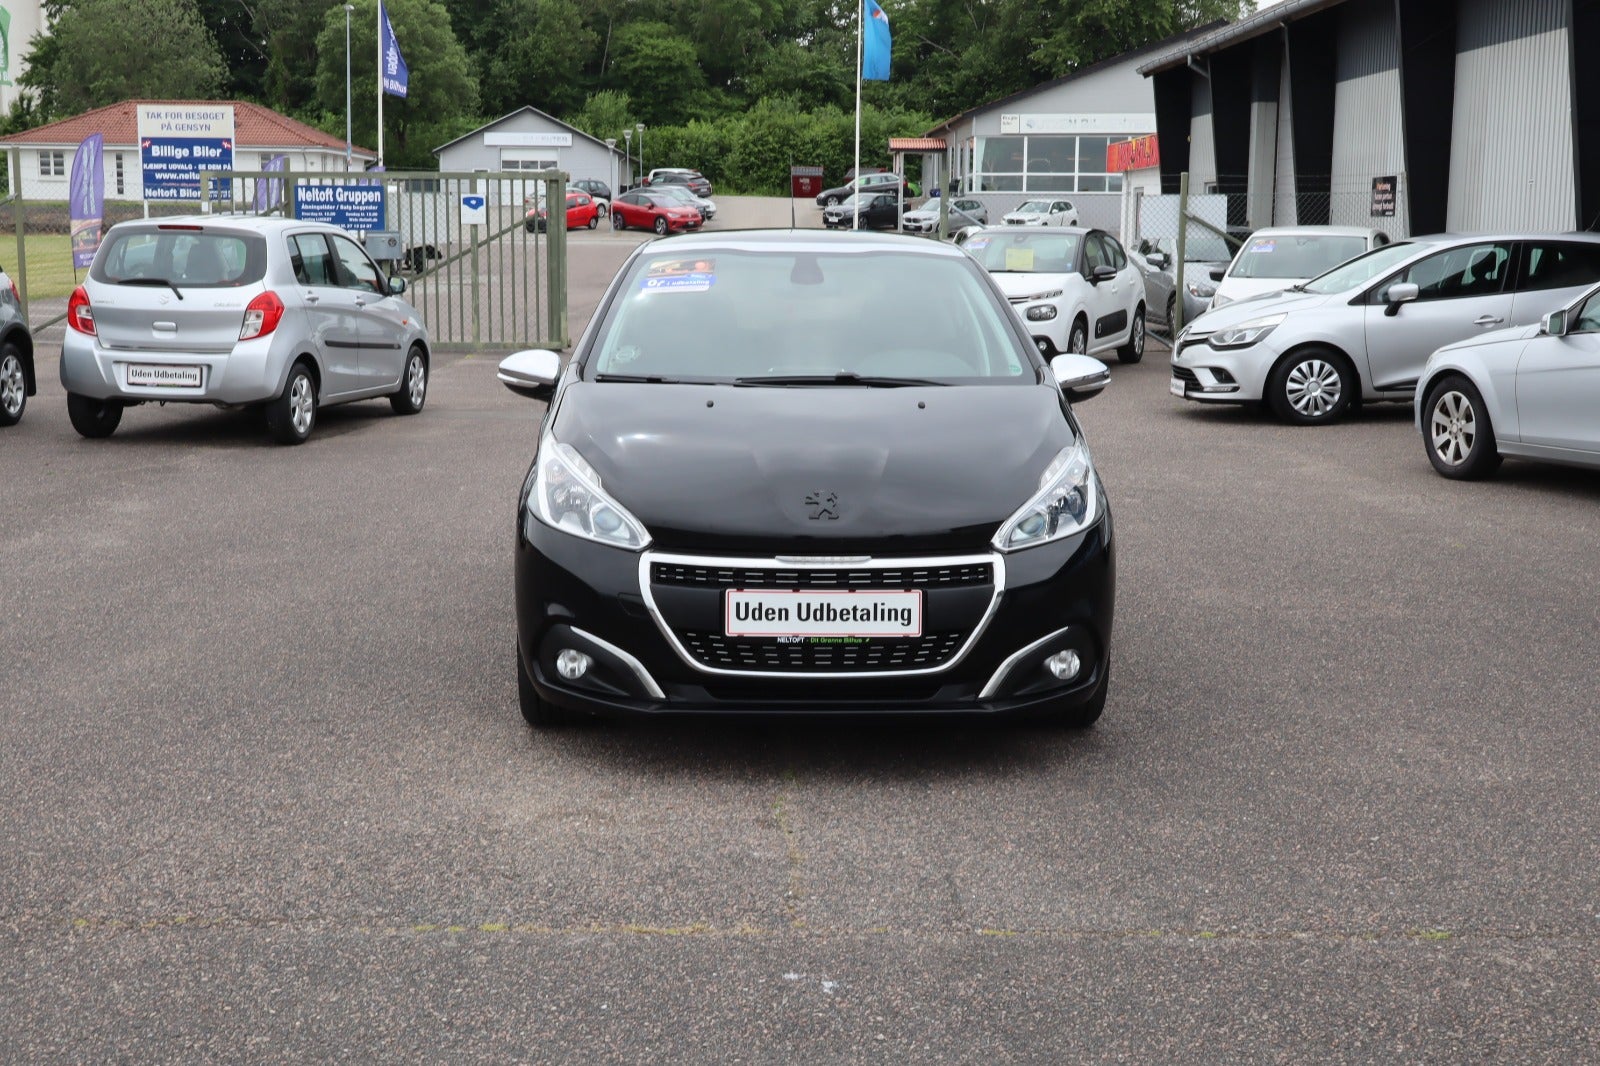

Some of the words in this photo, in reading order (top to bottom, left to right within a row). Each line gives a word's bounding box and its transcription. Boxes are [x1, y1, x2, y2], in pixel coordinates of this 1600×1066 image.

[146, 112, 162, 120] TAK
[165, 112, 183, 120] FOR
[185, 112, 225, 120] BESØGET
[161, 123, 172, 132] PÅ
[175, 124, 211, 132] GENSYN
[151, 145, 190, 159] Billige
[193, 145, 222, 158] Biler
[144, 188, 178, 198] Neltoft
[297, 187, 333, 202] Neltoft
[336, 187, 381, 205] Gruppen
[131, 369, 152, 378] Uden
[154, 370, 197, 382] Udbetaling
[735, 602, 789, 621] Uden
[797, 602, 912, 627] Udbetaling
